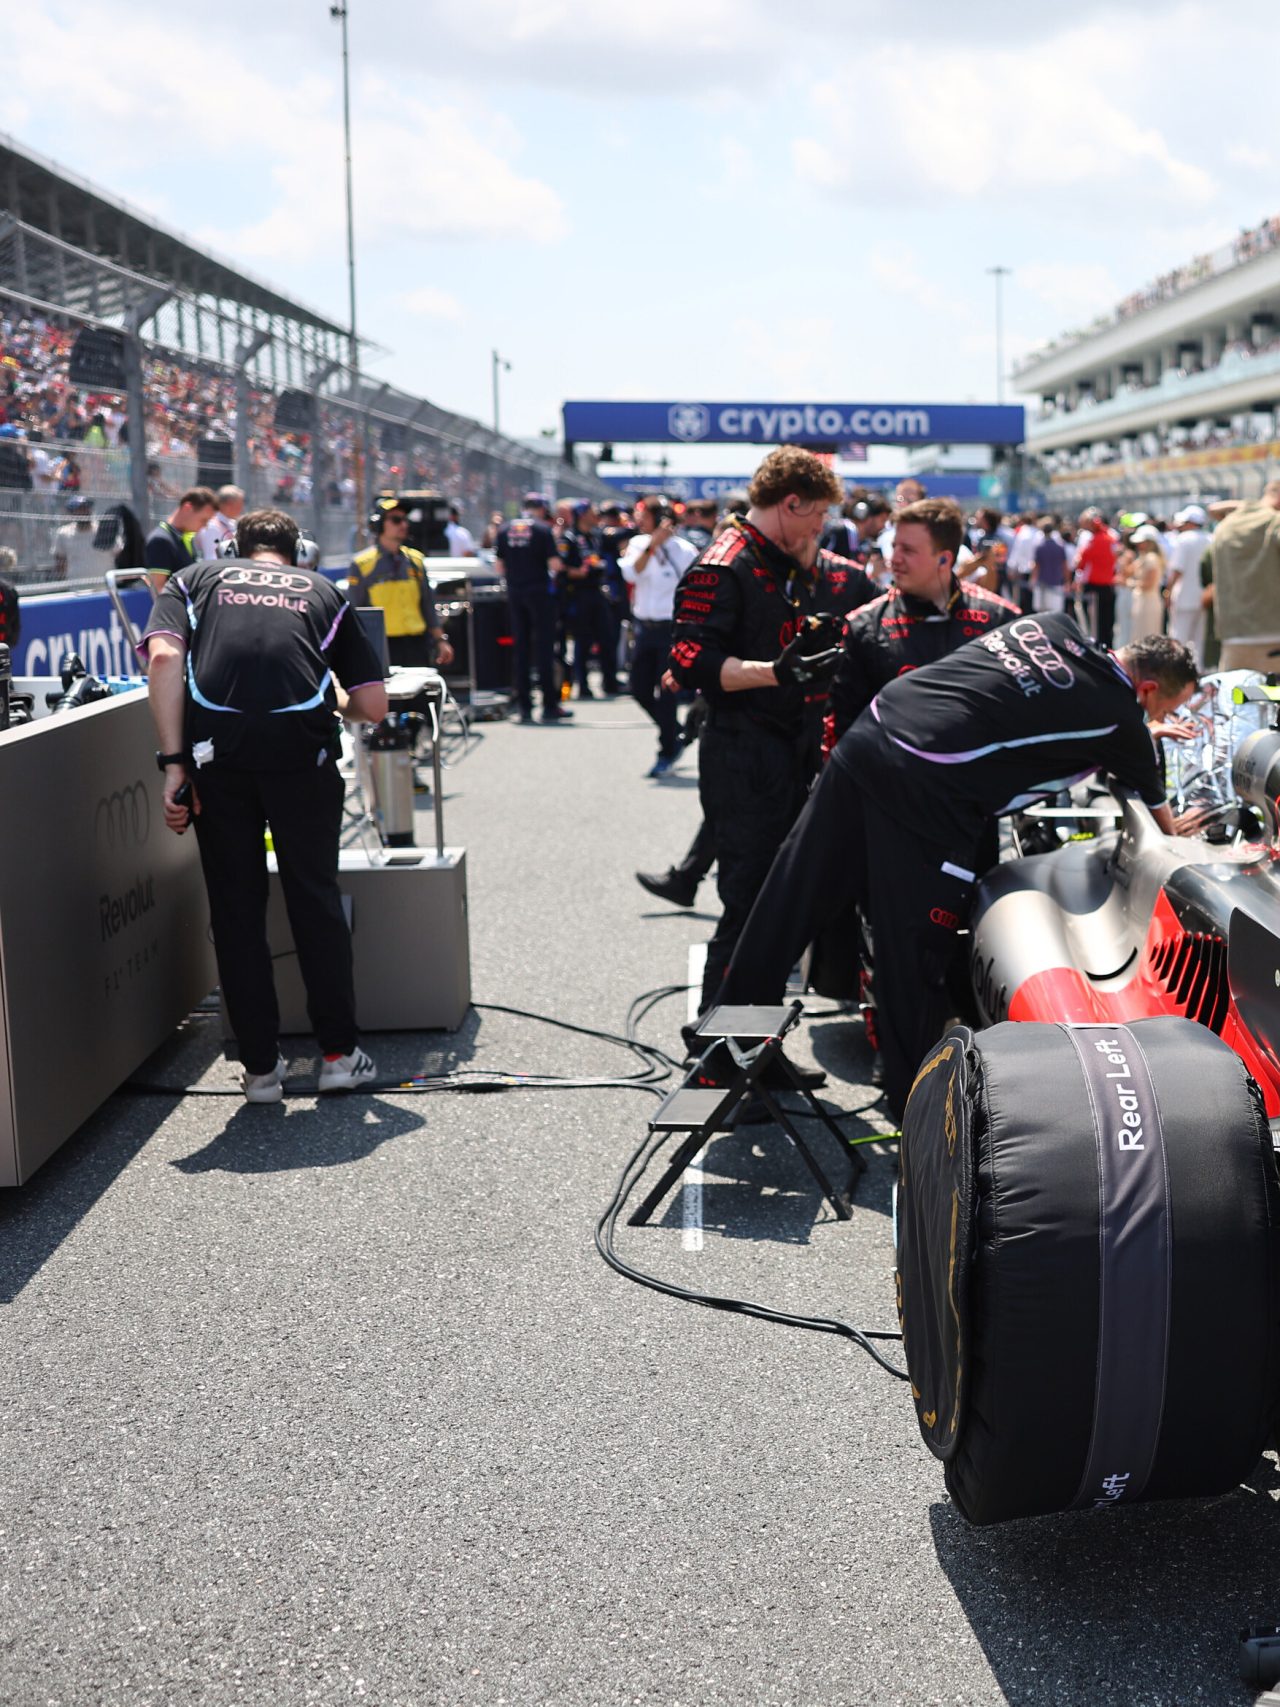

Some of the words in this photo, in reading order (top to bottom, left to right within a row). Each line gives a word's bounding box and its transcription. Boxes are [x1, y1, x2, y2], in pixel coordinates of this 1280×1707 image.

[718, 406, 930, 438] crypto.com
[218, 588, 309, 613] Revolut
[100, 873, 155, 943] Revolut
[1094, 1039, 1132, 1078] Left
[1116, 1083, 1145, 1151] Rear
